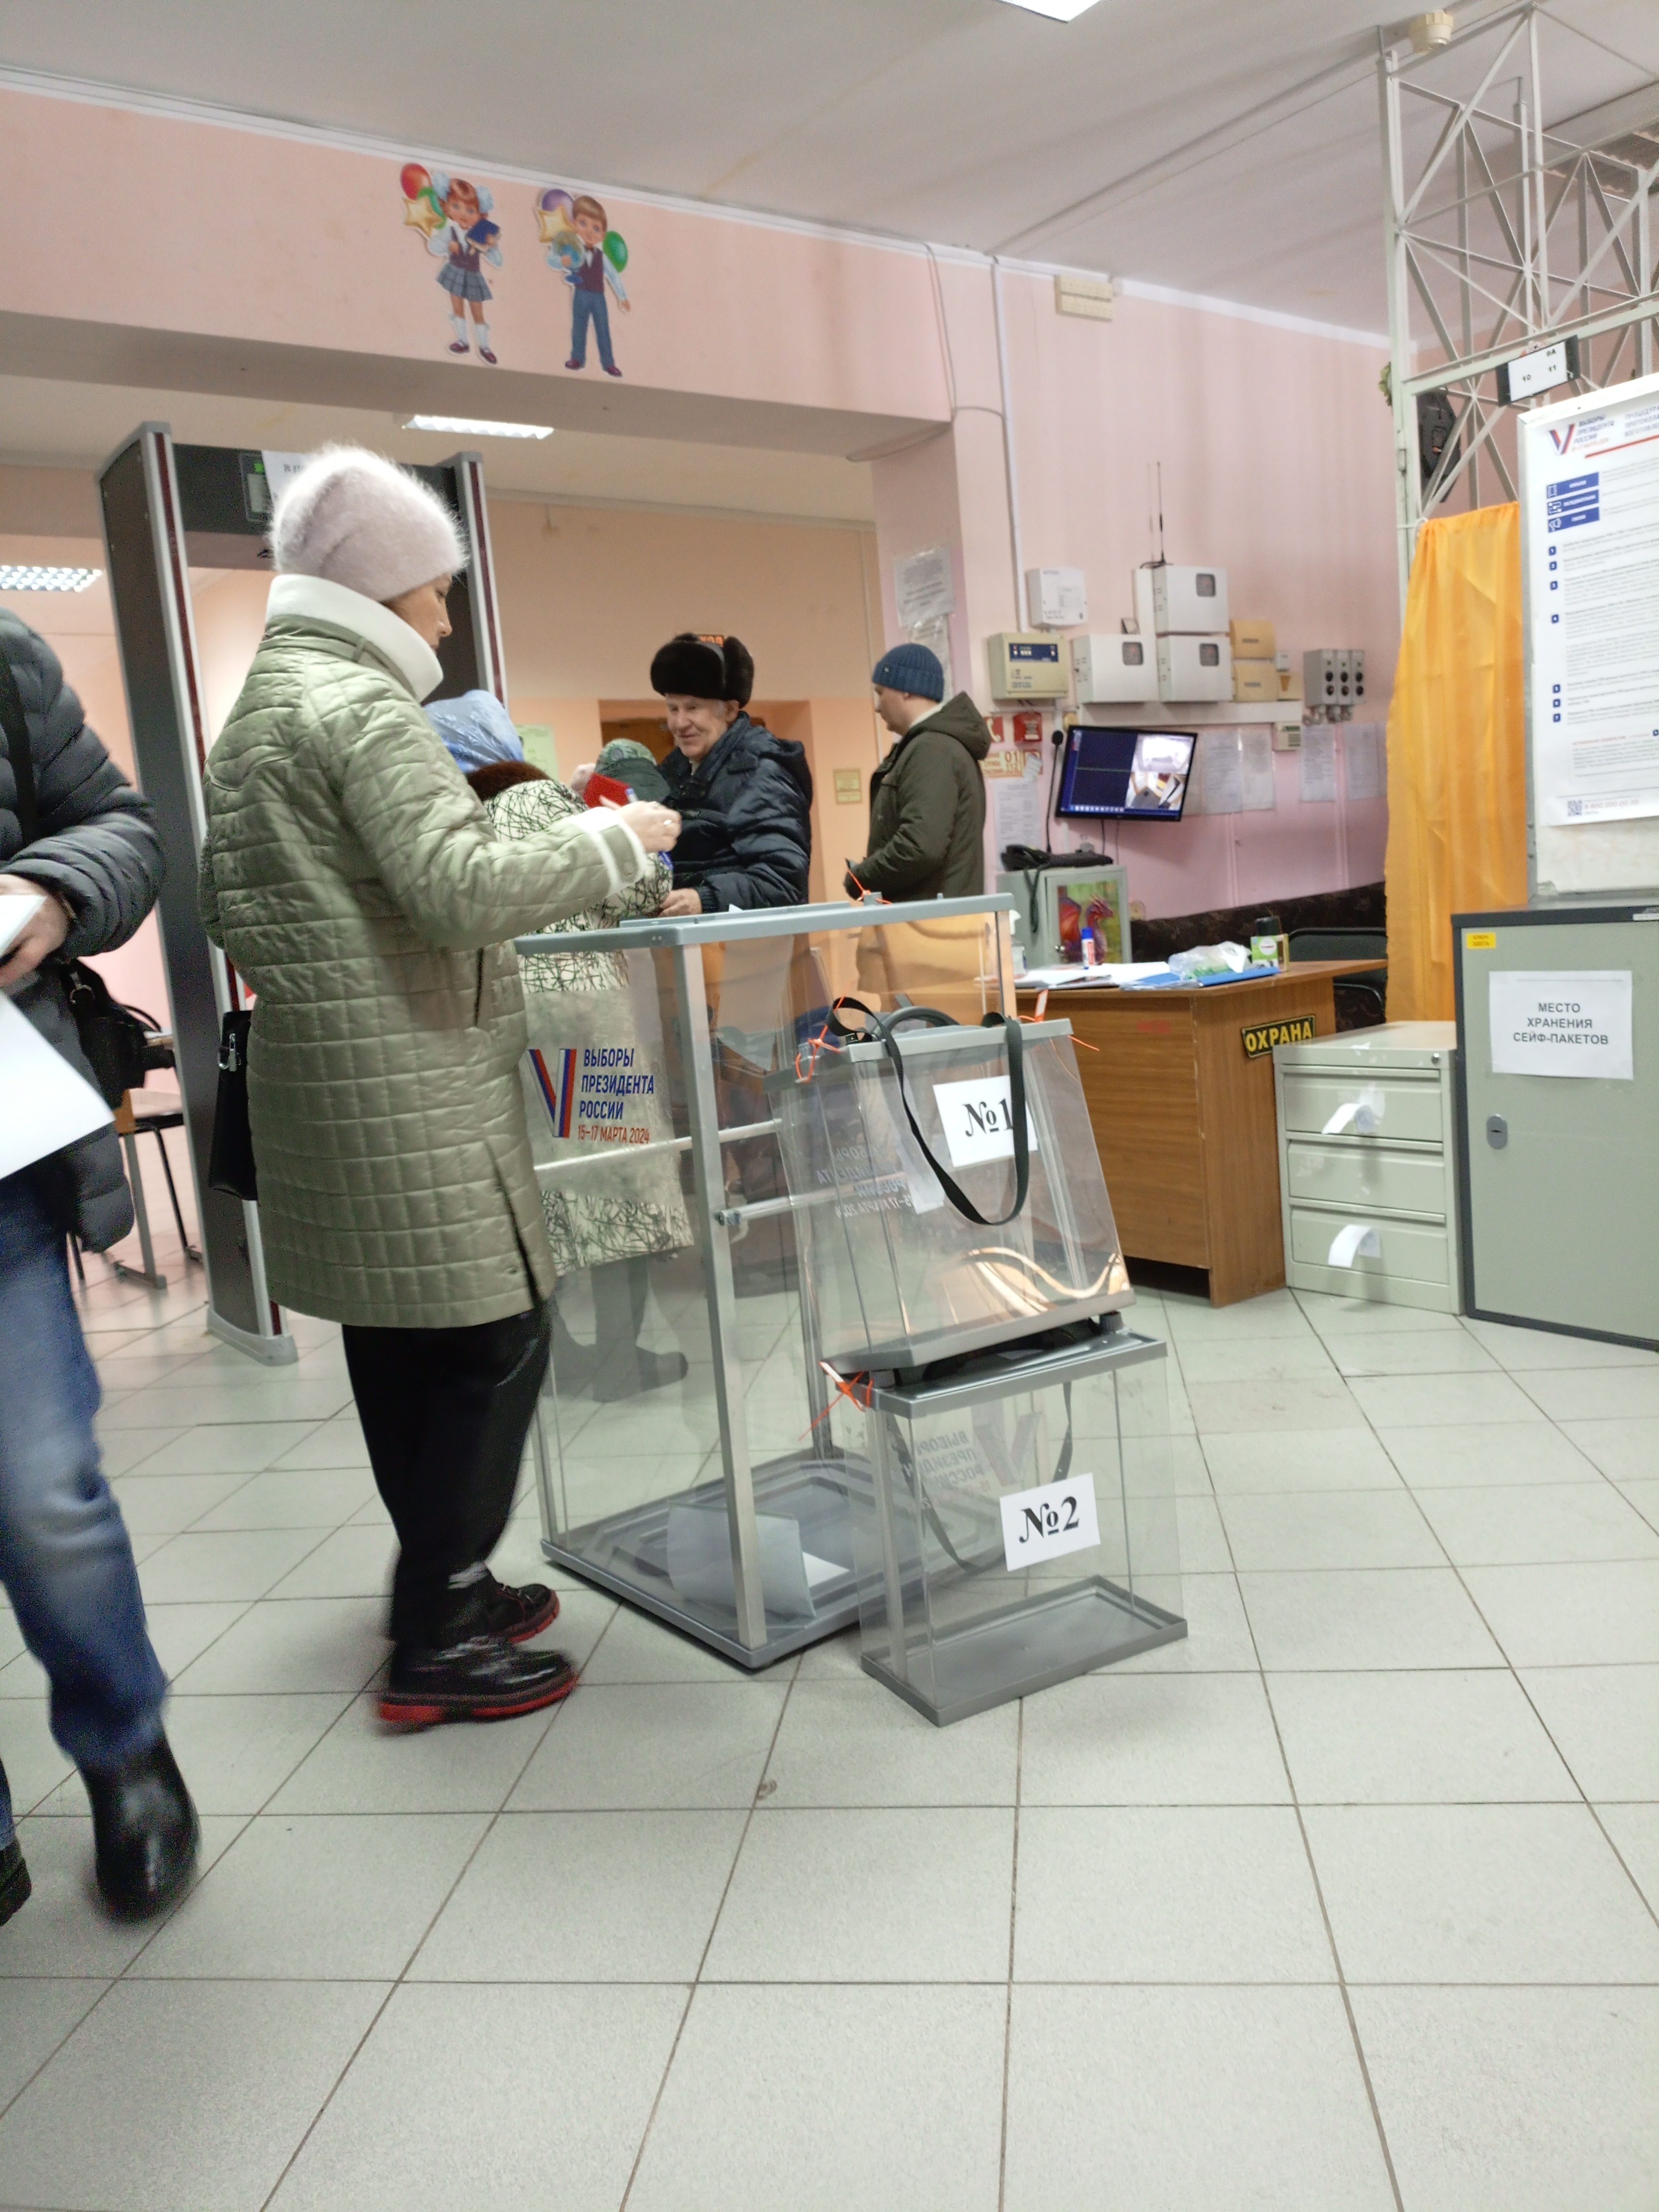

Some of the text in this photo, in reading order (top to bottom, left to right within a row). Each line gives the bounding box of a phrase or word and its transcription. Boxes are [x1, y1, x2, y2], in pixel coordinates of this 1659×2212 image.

[1538, 1003, 1580, 1013] МЕСТО
[1527, 1017, 1592, 1029] ХРАНЕНИЯ
[1245, 1021, 1312, 1052] ОХРАНА
[1514, 1031, 1609, 1045] СЕЙФ-ПАКЕТОВ
[583, 1048, 634, 1068] ВЫБОРЫ
[581, 1074, 654, 1096] ПРЕЗИДЕНТА
[579, 1100, 624, 1120] РОССИИ
[600, 1126, 627, 1143] МАРТА
[629, 1127, 650, 1144] 2024
[1018, 1496, 1080, 1544] №2
